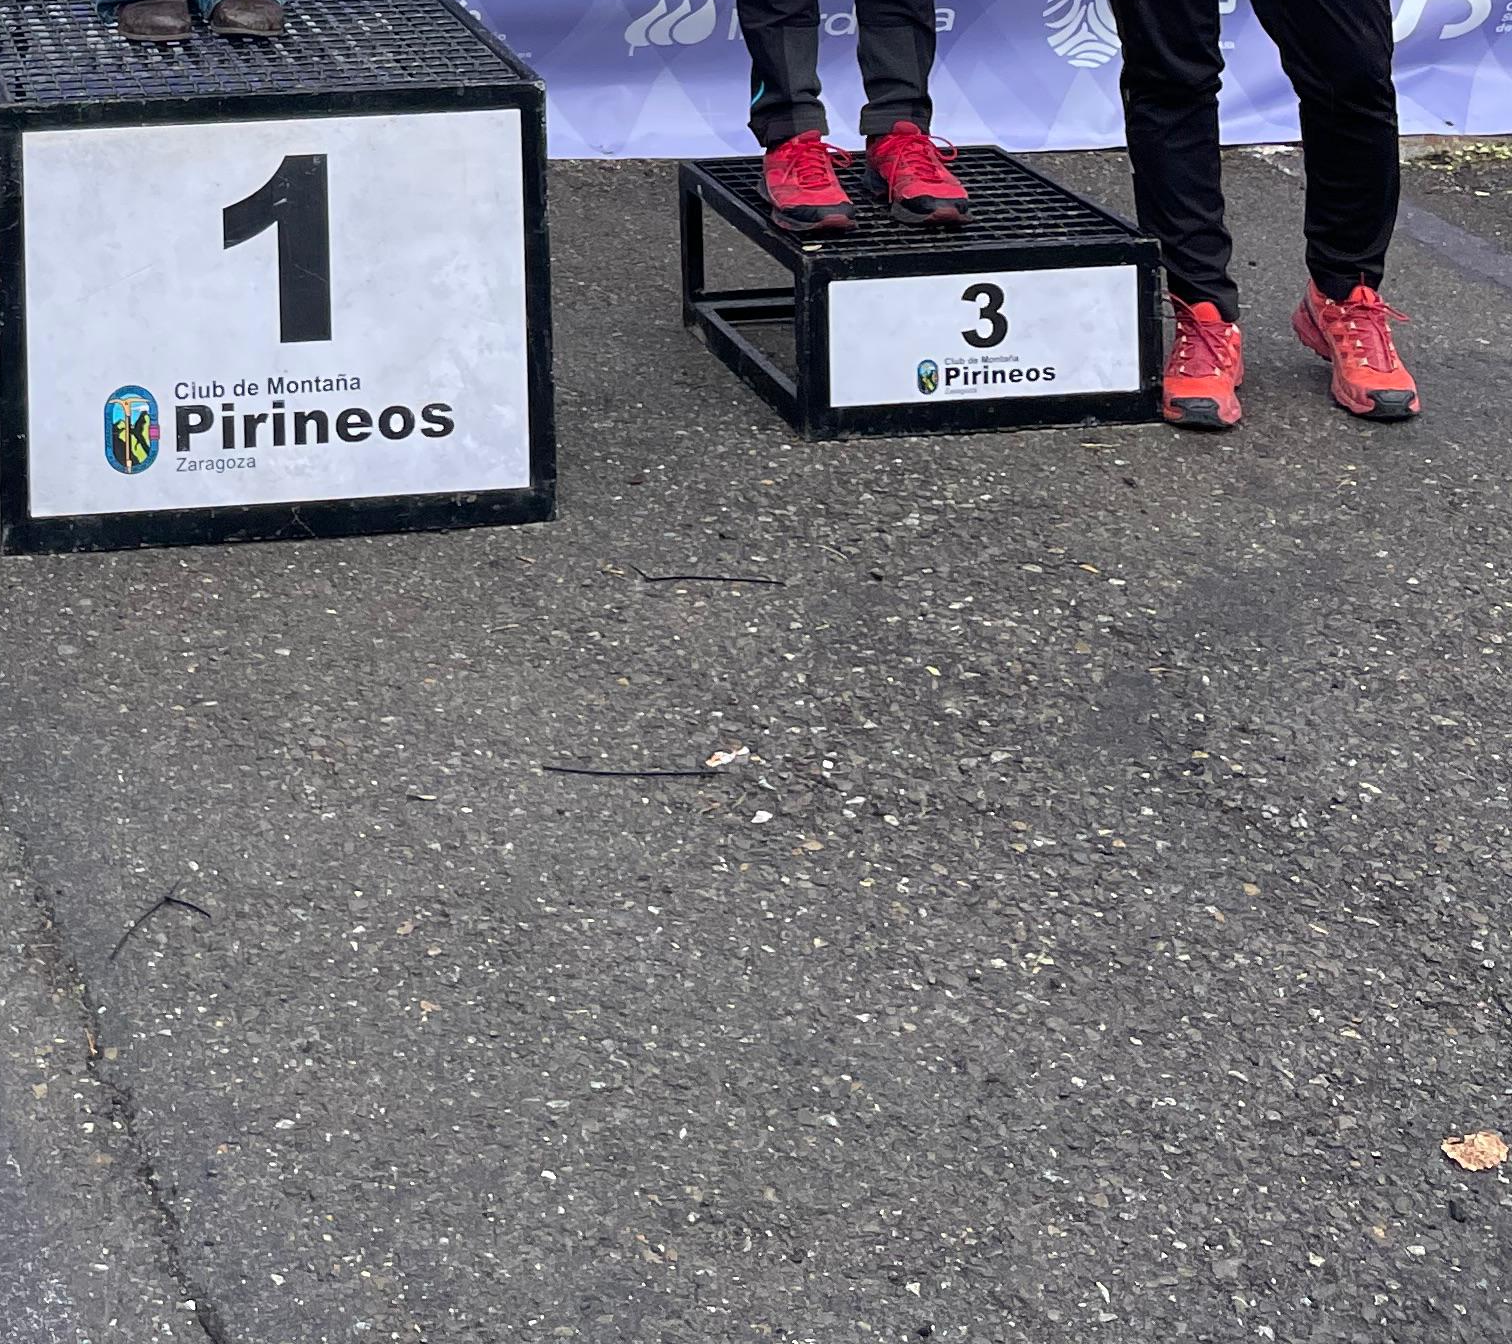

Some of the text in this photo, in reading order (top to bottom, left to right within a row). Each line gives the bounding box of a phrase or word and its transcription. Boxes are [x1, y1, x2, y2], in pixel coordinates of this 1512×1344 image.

[222, 153, 332, 343] 1
[961, 283, 1008, 348] 3
[174, 373, 361, 400] Club de Montaña
[945, 365, 1056, 386] Pirineos
[175, 399, 455, 452] Pirineos
[176, 456, 257, 474] Zaragoza
